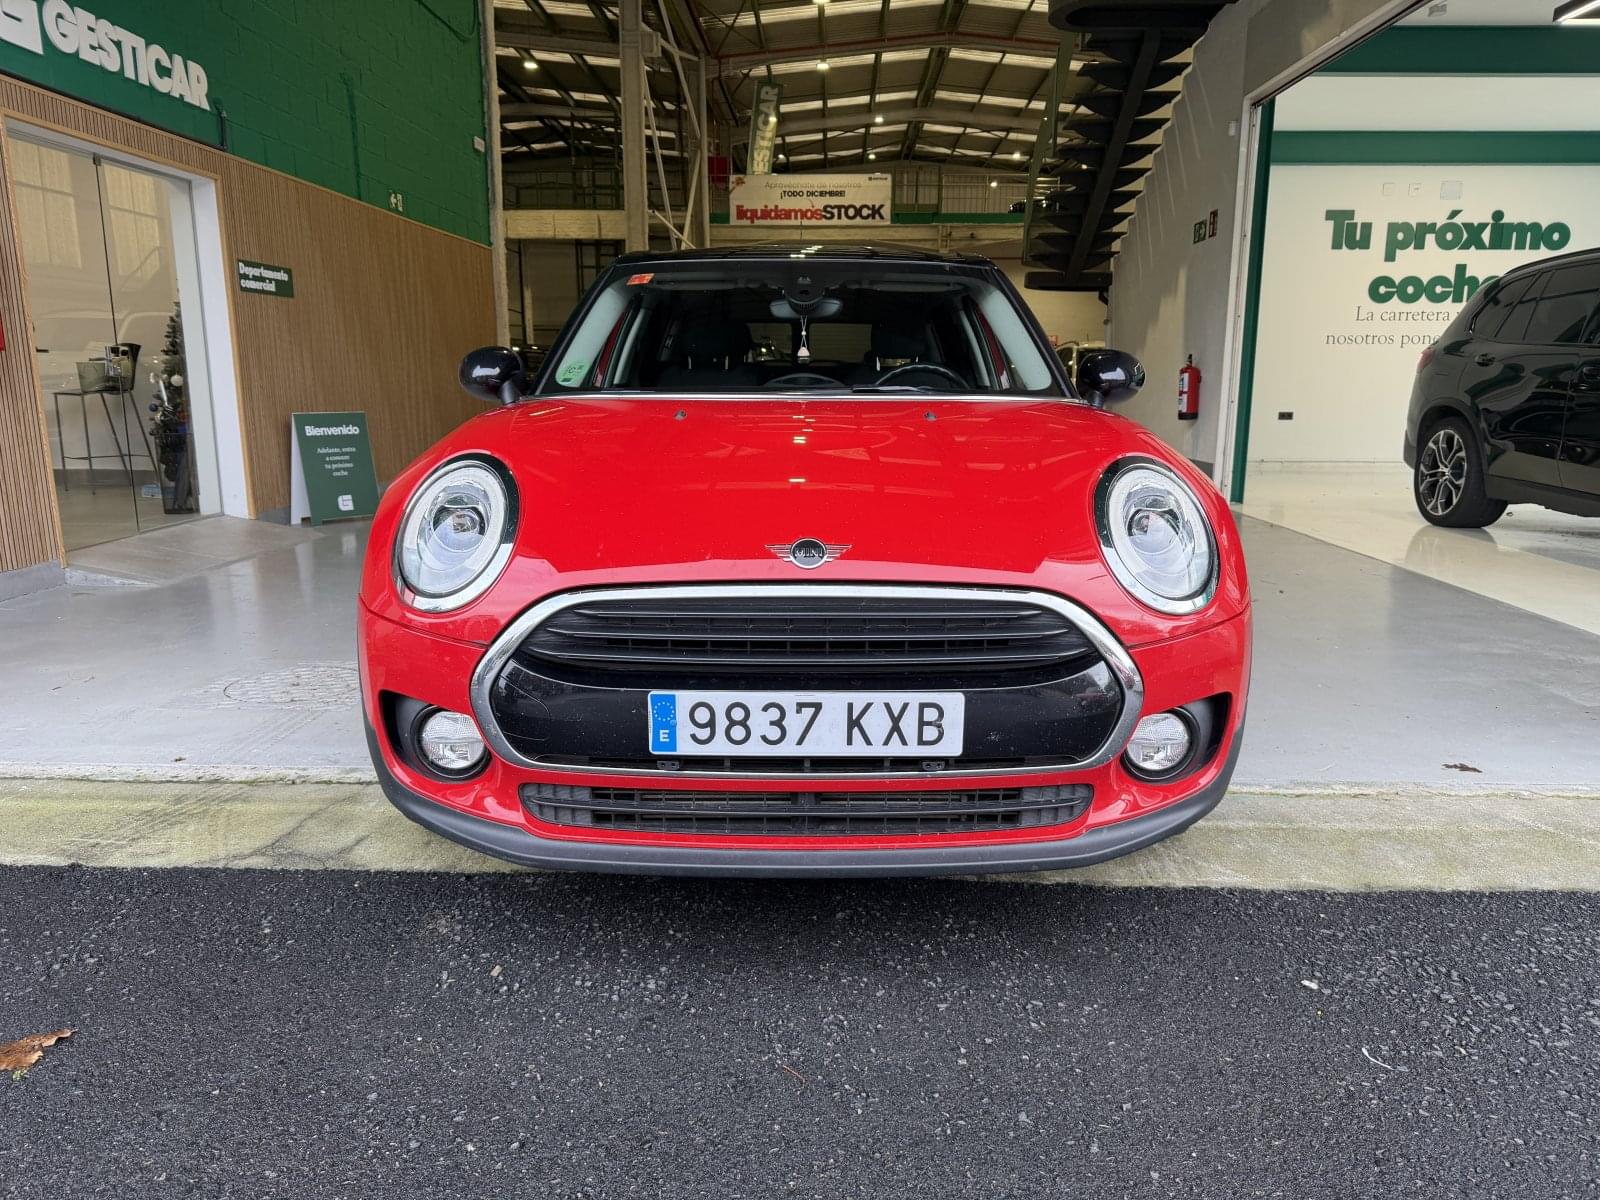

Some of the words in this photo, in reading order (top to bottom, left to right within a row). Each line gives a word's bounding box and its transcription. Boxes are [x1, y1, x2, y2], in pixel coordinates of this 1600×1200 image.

[42, 0, 211, 111] GESTICAR
[752, 86, 779, 175] ESTICAR
[780, 190, 804, 199] ¡TODO
[806, 190, 846, 198] DICIEMBRE!
[1325, 209, 1373, 250] Tu
[1384, 209, 1571, 262] próximo
[239, 262, 289, 281] Departamento
[240, 279, 276, 292] comercial
[1368, 264, 1500, 304] coch
[1355, 306, 1374, 322] La
[1380, 308, 1450, 322] carretera
[1325, 333, 1395, 345] nosotros
[304, 424, 360, 436] Bienvenido
[659, 729, 670, 742] E
[688, 701, 823, 746] 9837
[846, 701, 945, 746] KXB
